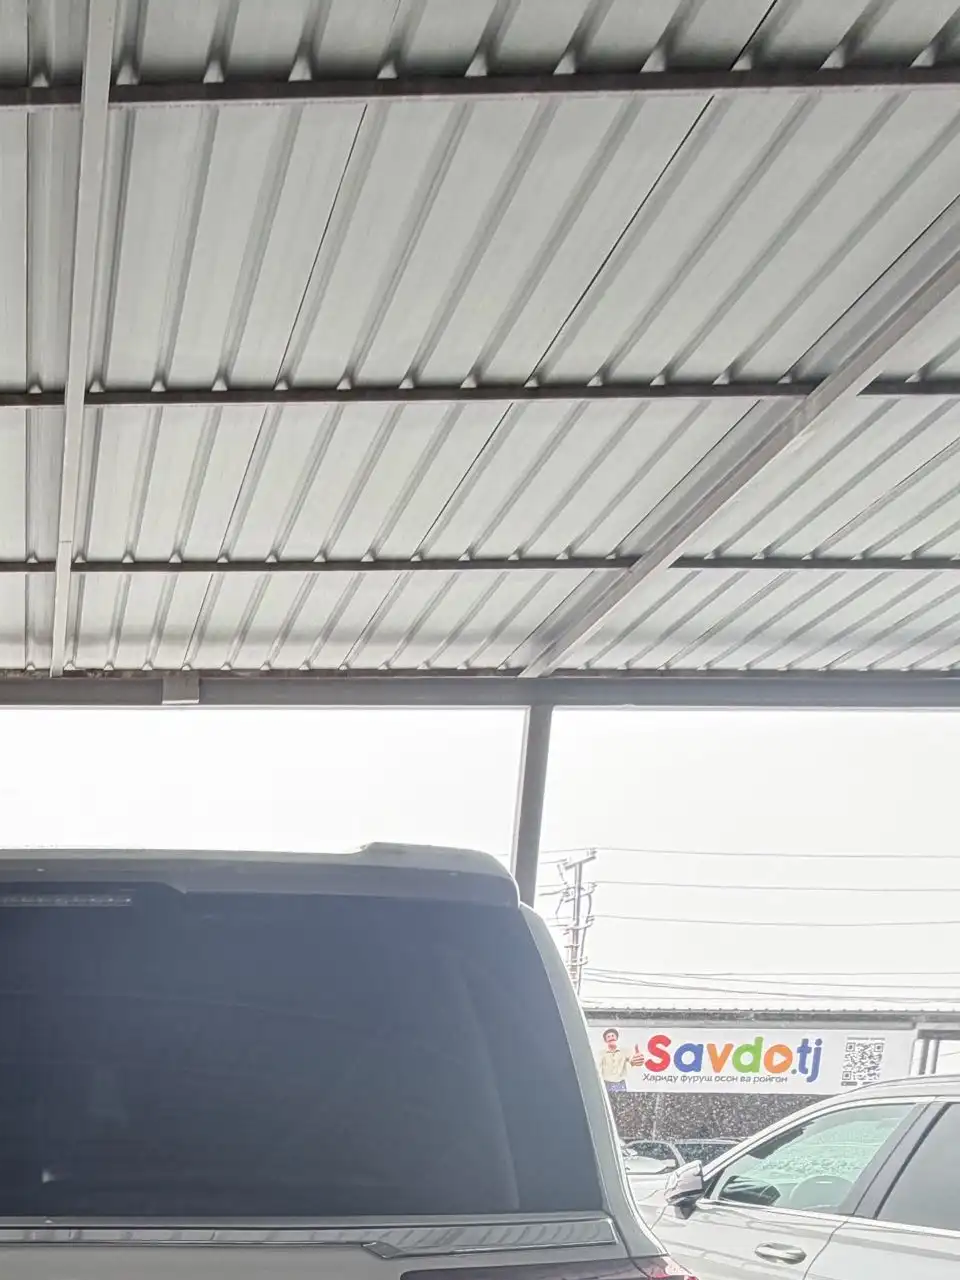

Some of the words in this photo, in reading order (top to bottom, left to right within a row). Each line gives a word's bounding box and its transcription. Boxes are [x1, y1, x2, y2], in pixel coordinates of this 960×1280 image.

[645, 1034, 823, 1083] Savdo.tj
[642, 1073, 679, 1083] Хариду
[680, 1074, 712, 1083] фуруш
[753, 1074, 788, 1083] ройгон
